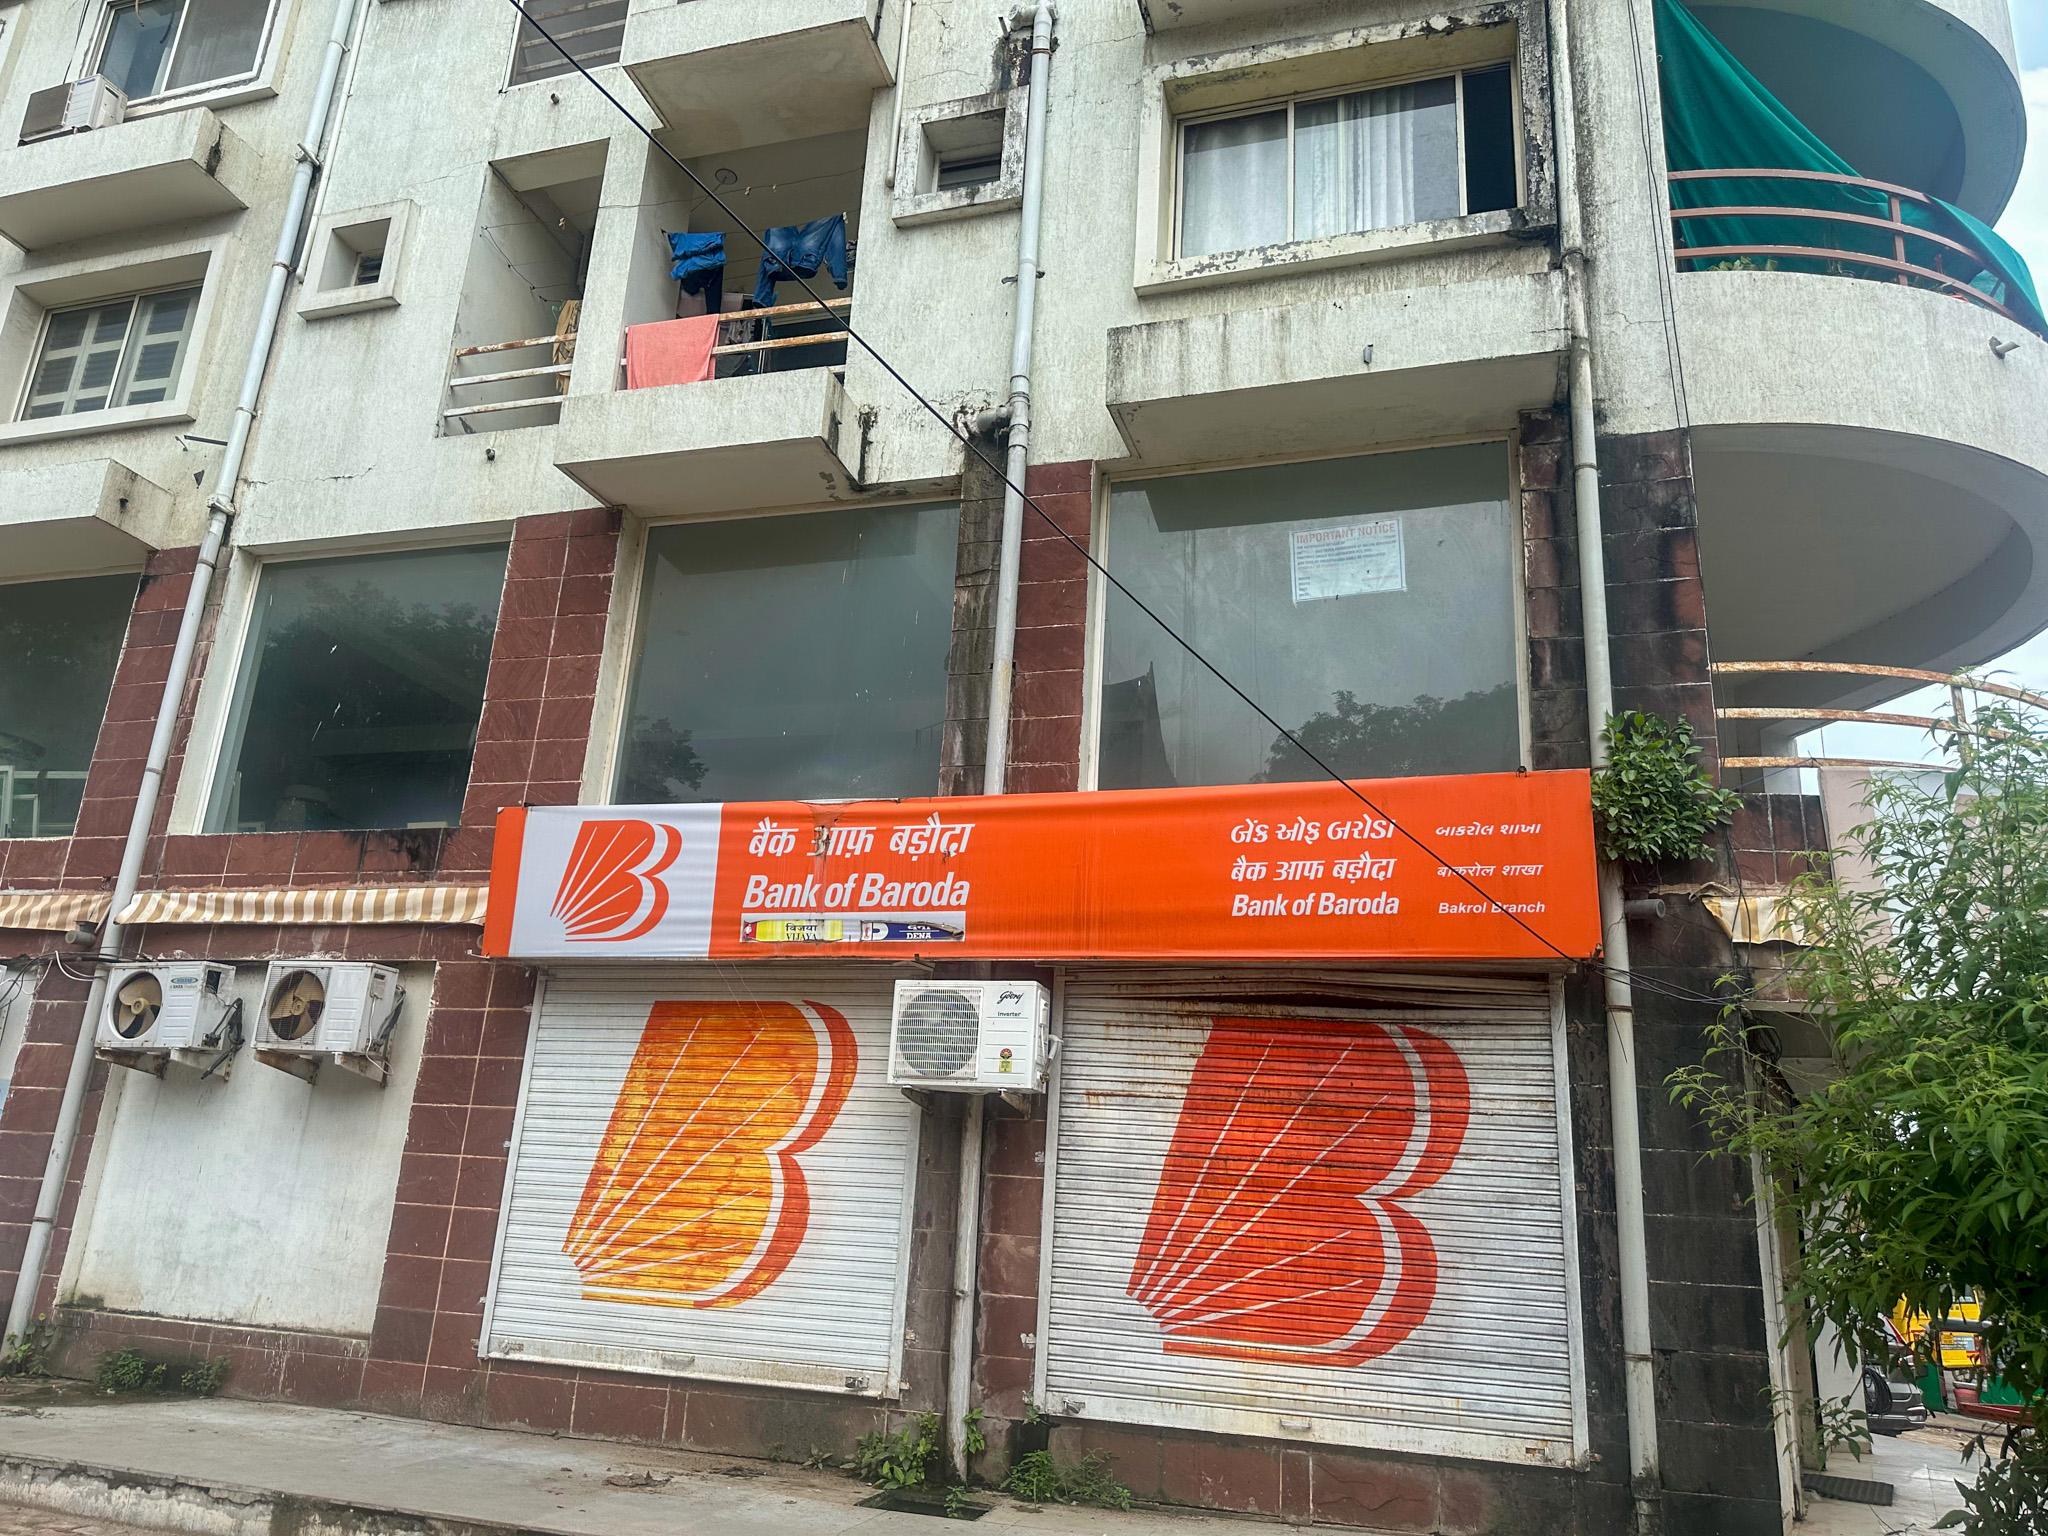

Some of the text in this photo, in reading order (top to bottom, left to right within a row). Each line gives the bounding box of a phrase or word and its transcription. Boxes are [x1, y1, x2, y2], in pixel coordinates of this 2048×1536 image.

[1296, 523, 1396, 544] IMPORTANT NOTICE
[748, 816, 799, 857] बैंक
[1230, 813, 1397, 845] બેંક ઓફ બરોડા
[1435, 821, 1542, 836] બાકરોલ શાખા
[1332, 851, 1398, 884] बड़ौदा
[1437, 862, 1544, 877] बाकरोल शाखा
[742, 871, 970, 908] Bank of Baroda
[1231, 891, 1400, 917] Bank of Baroda
[1438, 901, 1546, 914] Bakrol Branch
[786, 932, 818, 941] VIJAYA
